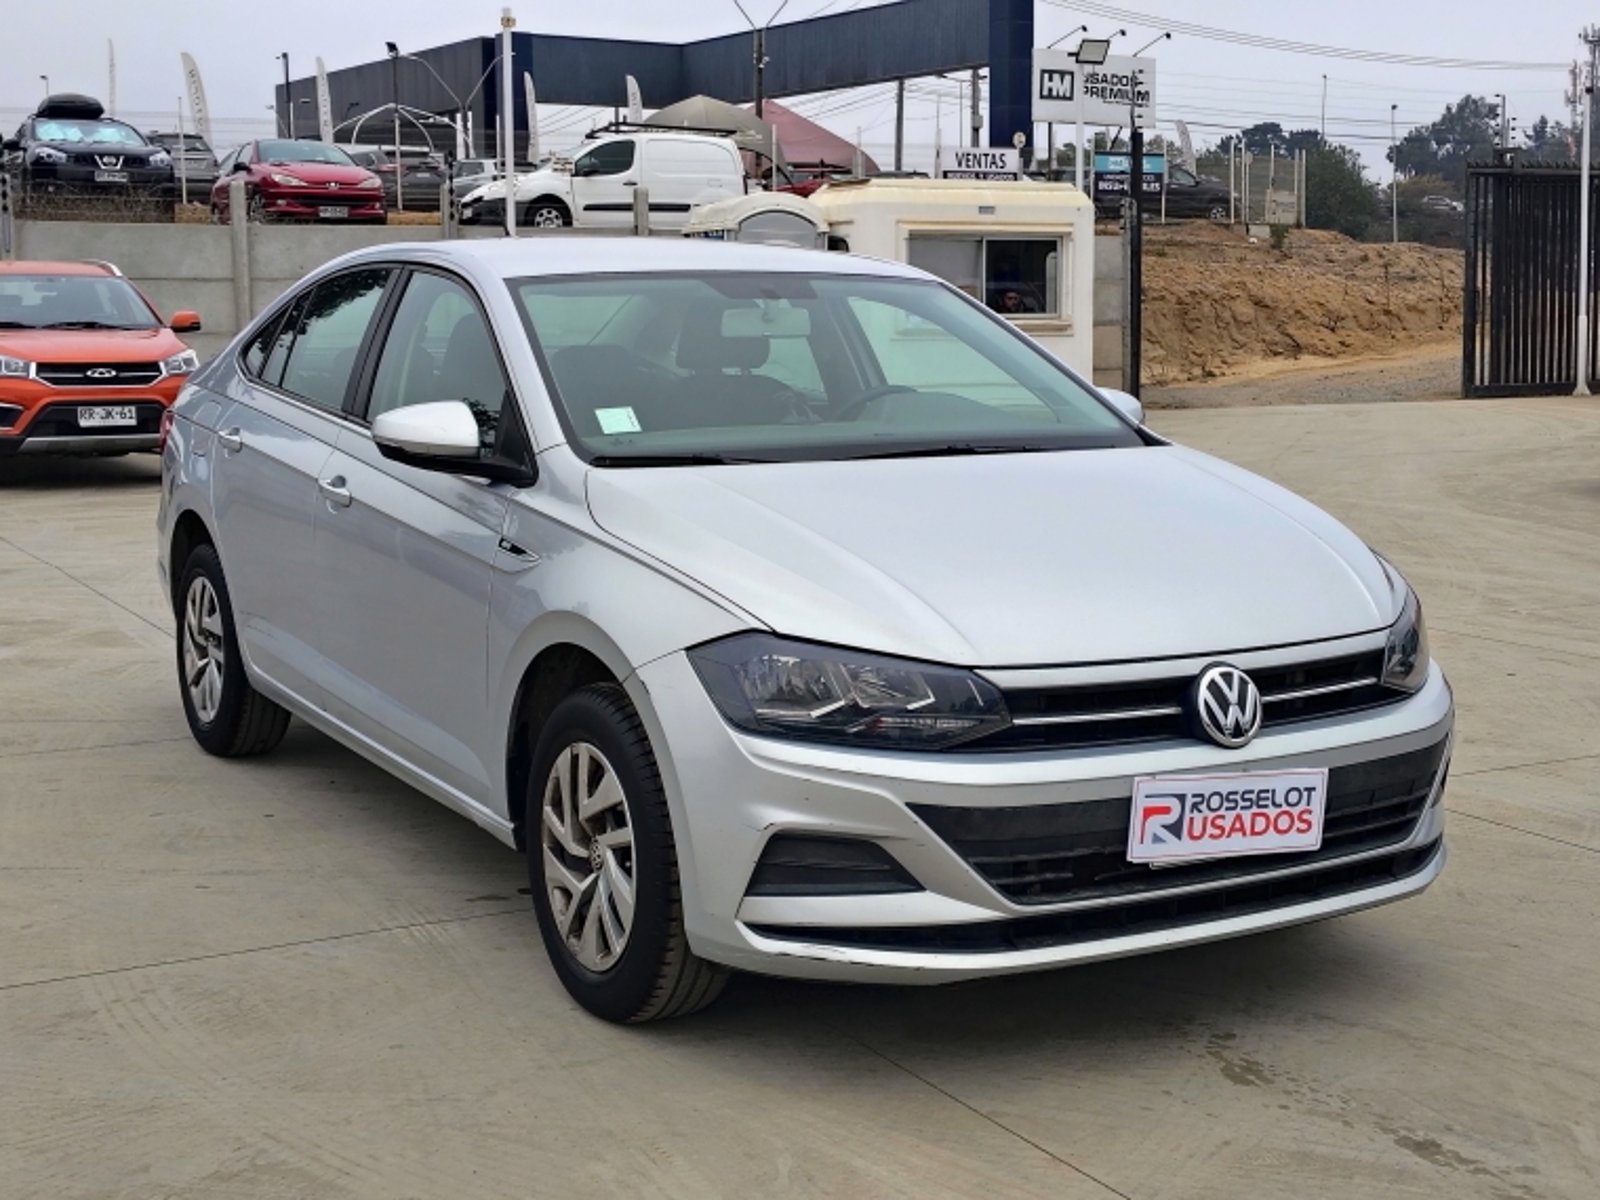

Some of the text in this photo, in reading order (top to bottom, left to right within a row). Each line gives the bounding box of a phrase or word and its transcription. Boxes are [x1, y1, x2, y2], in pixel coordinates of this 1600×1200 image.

[1041, 72, 1073, 98] HM
[955, 152, 1007, 169] VENTAS
[1190, 787, 1316, 813] ROSSELOT
[1186, 808, 1312, 841] USADOS
